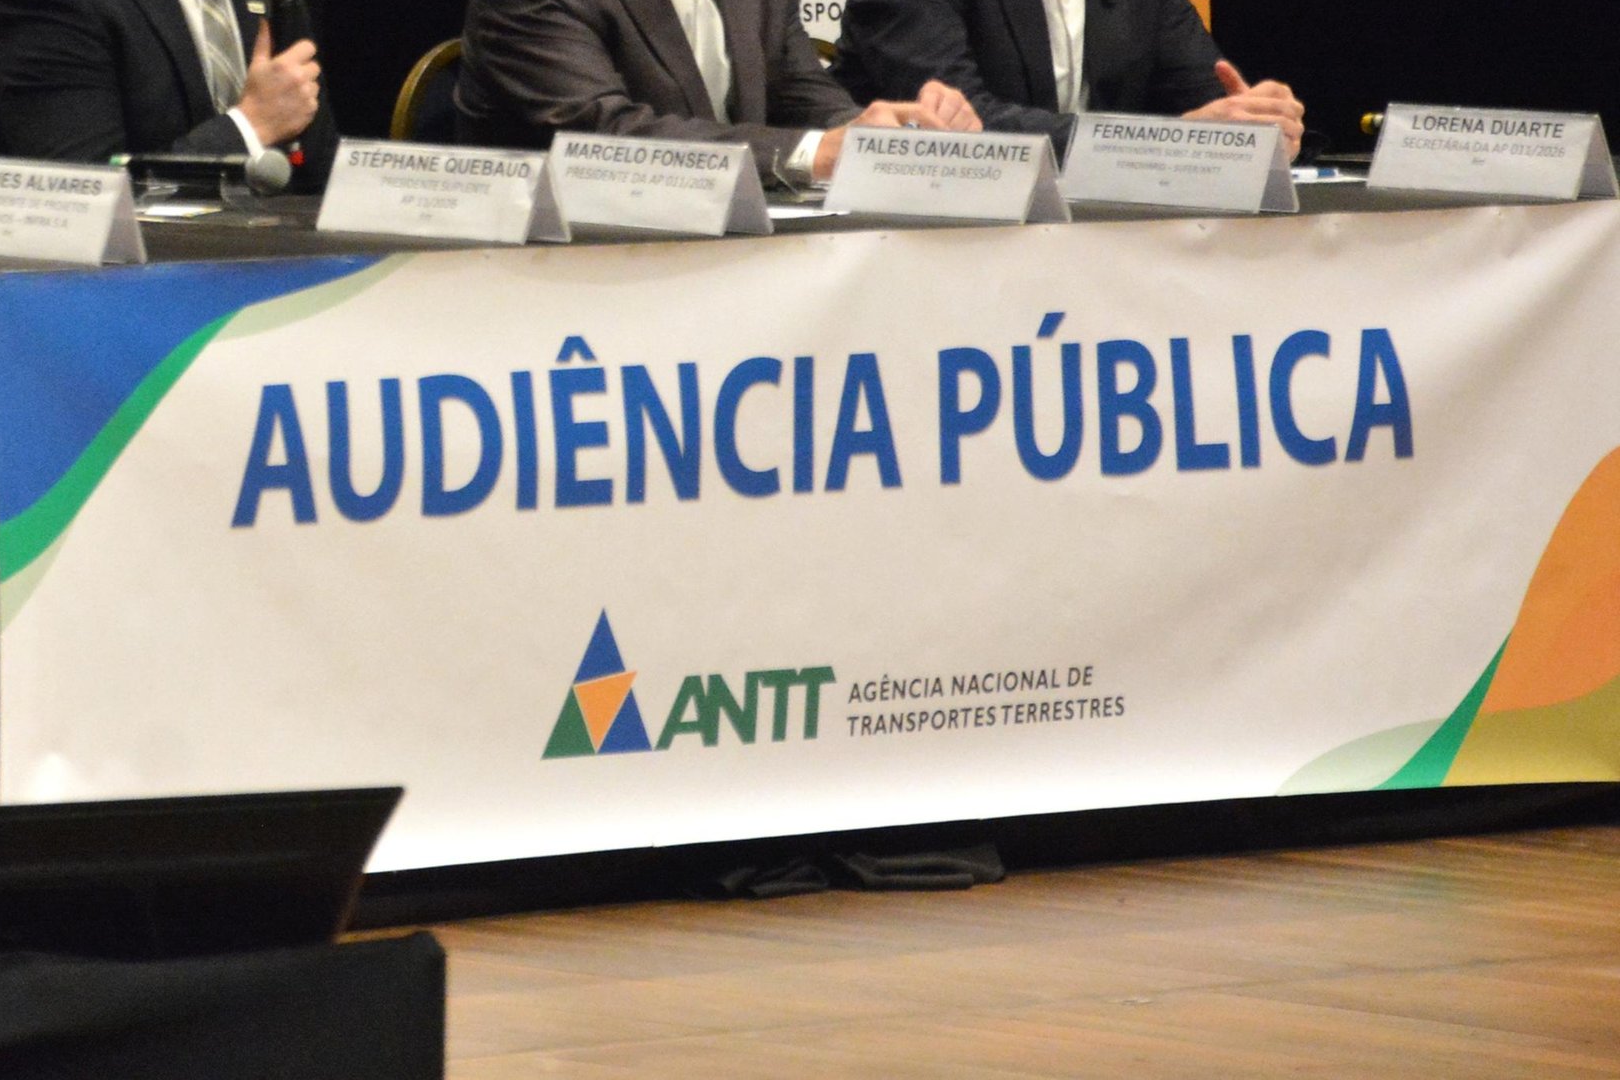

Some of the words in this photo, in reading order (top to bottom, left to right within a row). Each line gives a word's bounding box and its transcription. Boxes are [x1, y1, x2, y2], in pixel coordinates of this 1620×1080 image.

[1093, 124, 1183, 143] FERNANDO
[1187, 130, 1257, 148] FEITOSA
[1412, 115, 1484, 134] LORENA
[1491, 120, 1564, 139] DUARTE
[565, 142, 647, 164] MARCELO
[651, 149, 730, 170] FONSECA
[857, 137, 910, 155] TALES
[915, 139, 1031, 162] CAVALCANTE
[1472, 142, 1489, 153] DA
[1492, 143, 1508, 154] AP
[348, 149, 440, 172] STÉPHANE
[445, 158, 530, 179] QUEBAUD
[25, 175, 102, 196] ALVARES
[231, 334, 901, 528] AUDIÊNCIA
[936, 310, 1415, 486] PÚBLICA
[848, 673, 944, 704] AGÊNCIA
[951, 667, 1062, 698] NACIONAL
[1067, 666, 1094, 688] DE
[653, 665, 837, 751] ANTT
[846, 704, 998, 737] TRANSPORTES
[1000, 696, 1126, 726] TERRESTRES
